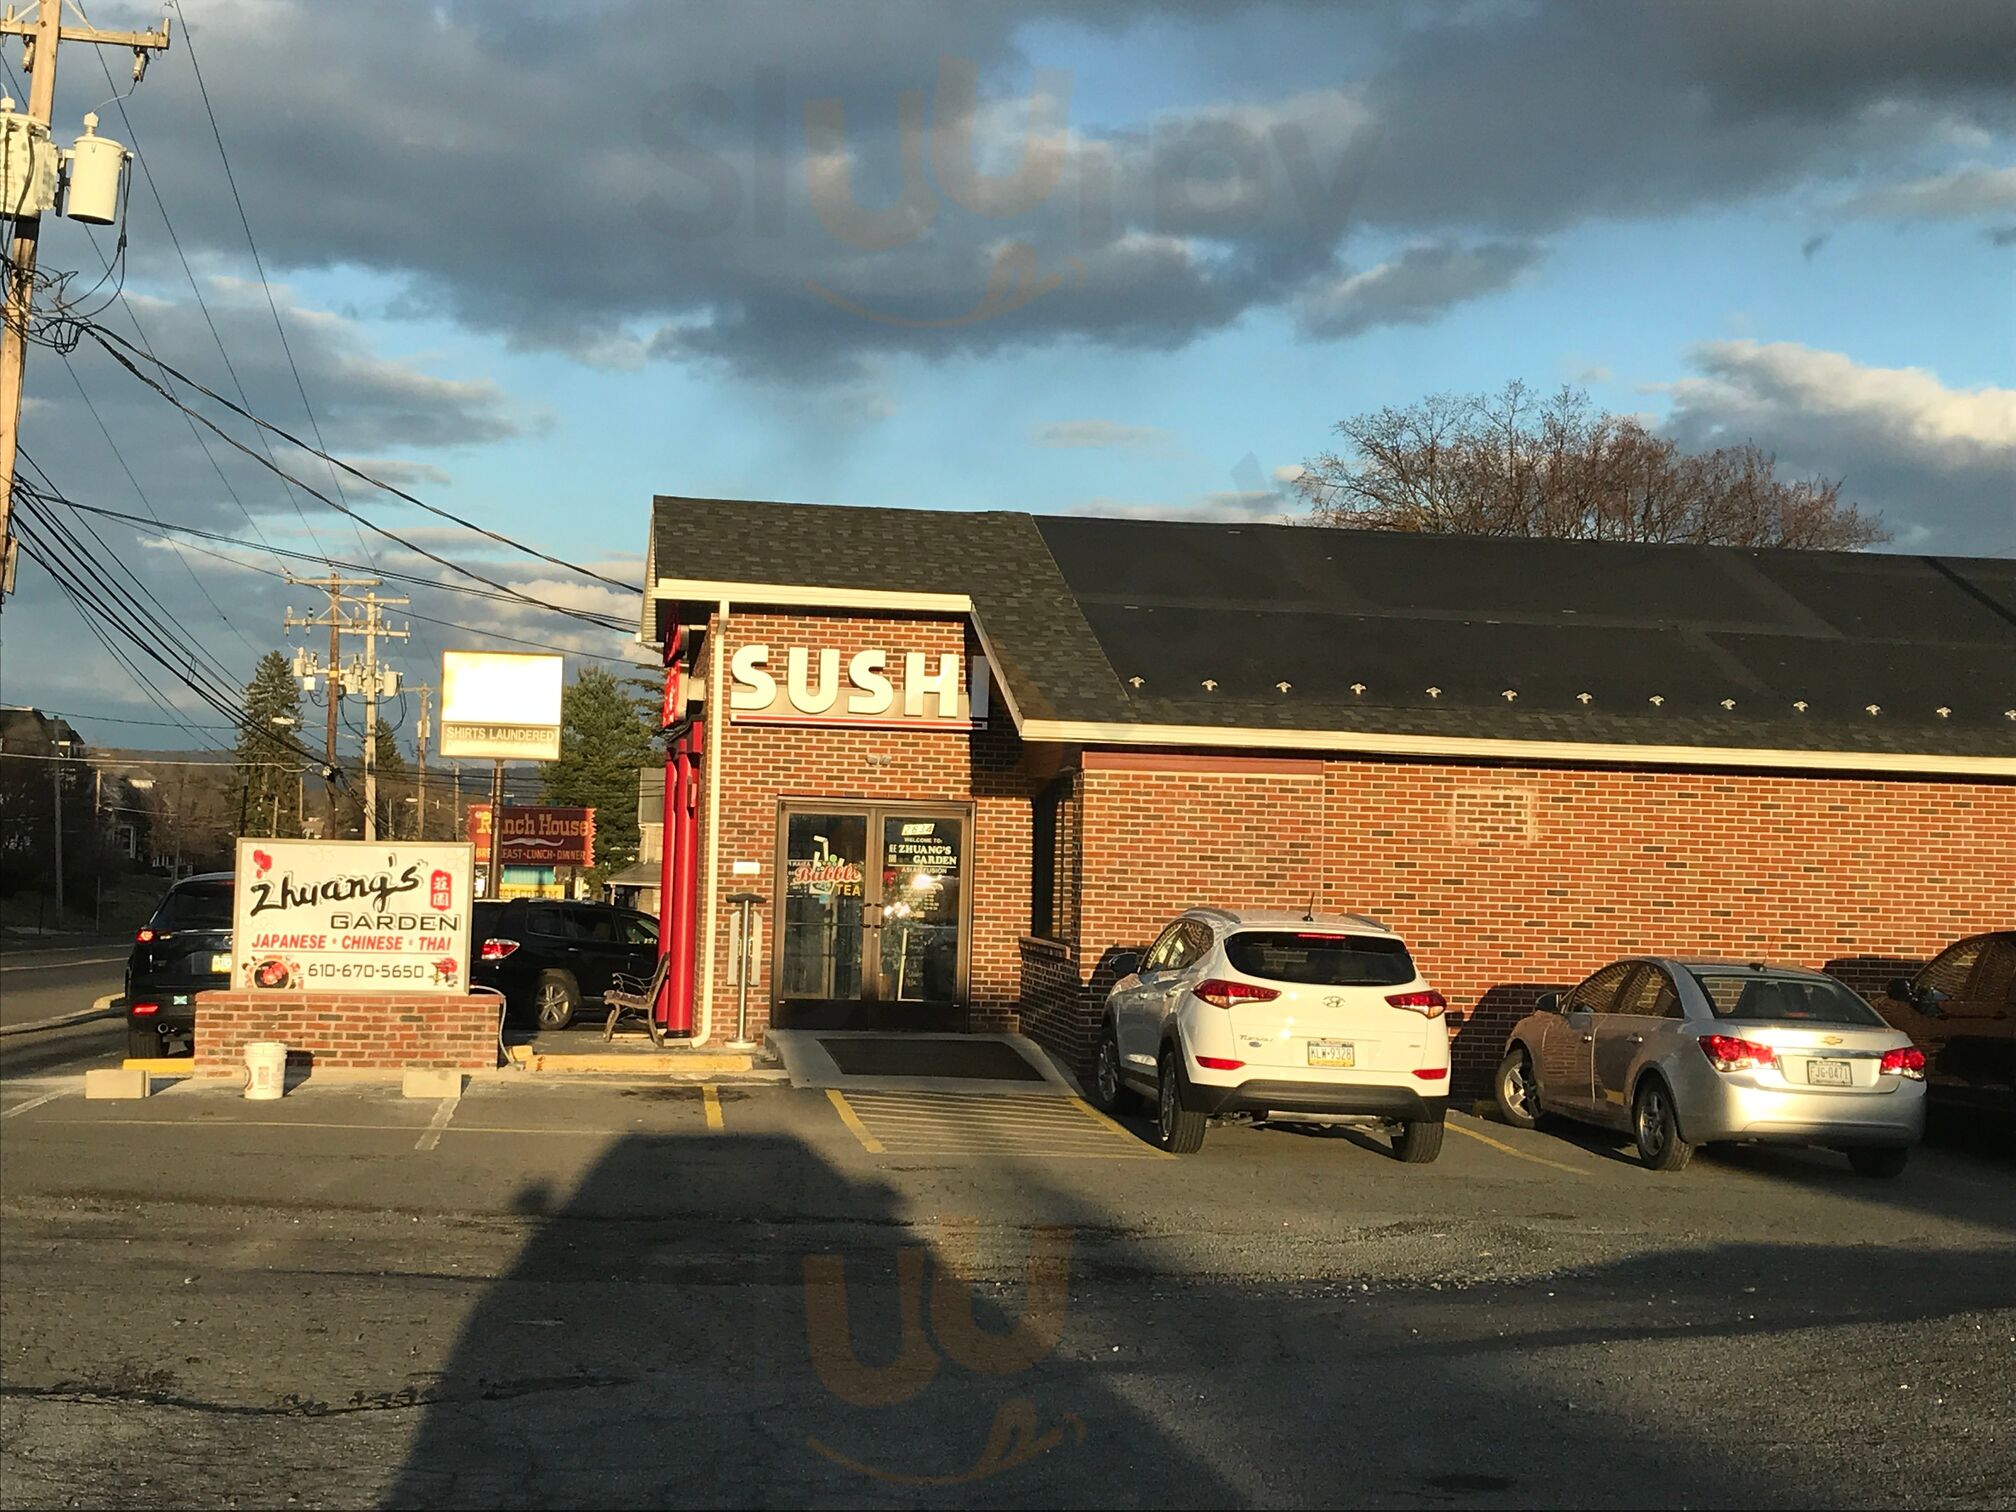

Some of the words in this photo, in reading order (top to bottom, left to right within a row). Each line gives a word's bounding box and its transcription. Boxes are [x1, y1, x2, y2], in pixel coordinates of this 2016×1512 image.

[730, 644, 990, 719] SUSHI
[446, 726, 486, 739] SHIRTS
[489, 728, 554, 742] LAUNDERED
[475, 811, 536, 835] Rnch
[538, 813, 589, 837] House
[526, 849, 553, 860] LUNCH
[556, 850, 587, 861] DINNER
[898, 845, 952, 855] ZHUANG'S
[912, 855, 958, 866] GARDEN
[793, 864, 862, 883] Bubble
[835, 884, 861, 897] TEA
[331, 913, 460, 932] GARDEN
[251, 934, 326, 950] JAPANESE
[341, 936, 403, 952] CHINESE
[418, 937, 452, 952] THAI
[308, 963, 424, 979] 610-670-5650
